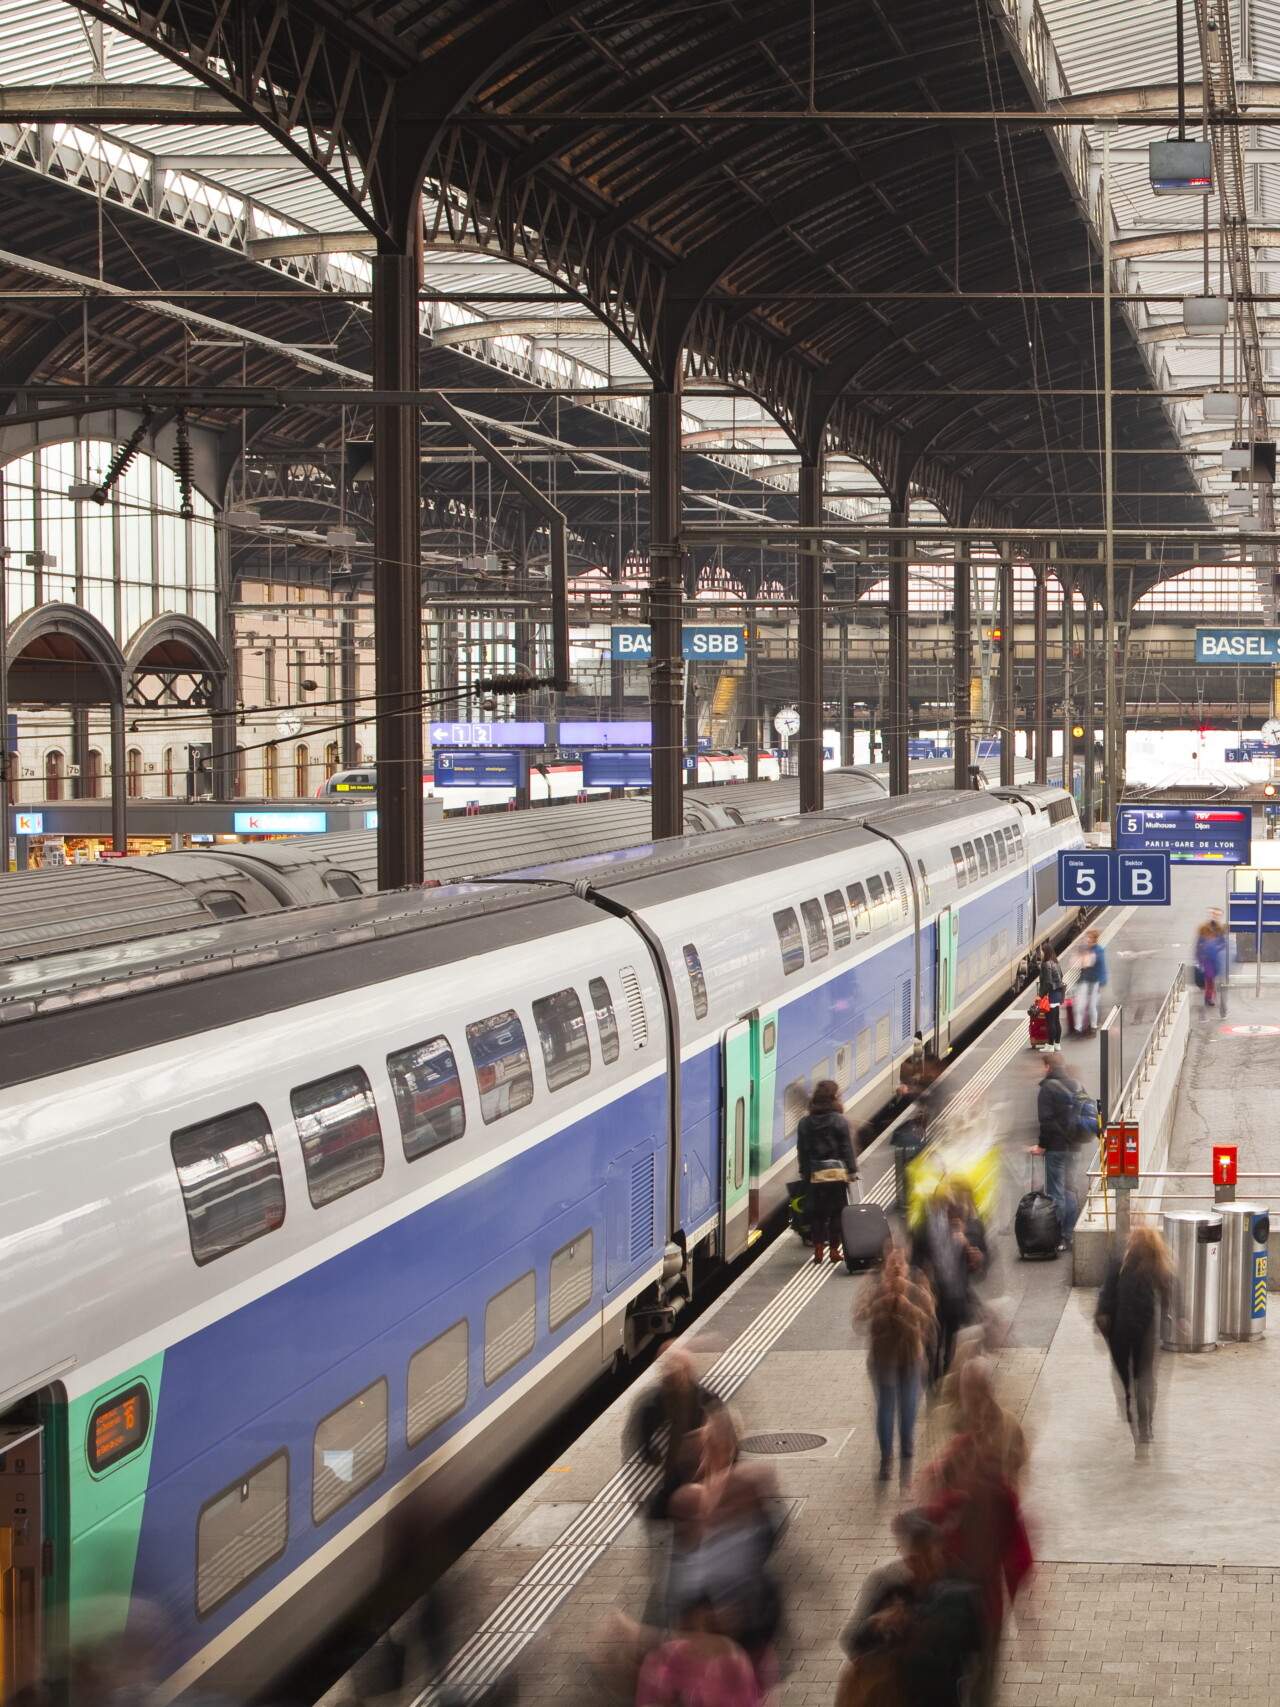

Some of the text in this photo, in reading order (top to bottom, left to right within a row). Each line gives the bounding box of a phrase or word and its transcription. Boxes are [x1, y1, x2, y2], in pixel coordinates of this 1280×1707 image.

[693, 634, 739, 653] SBB
[1202, 637, 1273, 656] BASEL
[458, 729, 464, 741] 1
[478, 729, 487, 741] 2
[1228, 752, 1249, 760] 5 A
[148, 763, 154, 771] 9
[442, 759, 450, 768] 3
[24, 768, 35, 777] 7a
[69, 766, 80, 775] 7b
[20, 816, 31, 829] k
[1127, 819, 1137, 831] 5
[1194, 822, 1210, 830] Dijon
[1145, 840, 1195, 848] PARIS-GARE
[1076, 868, 1154, 896] 5 B
